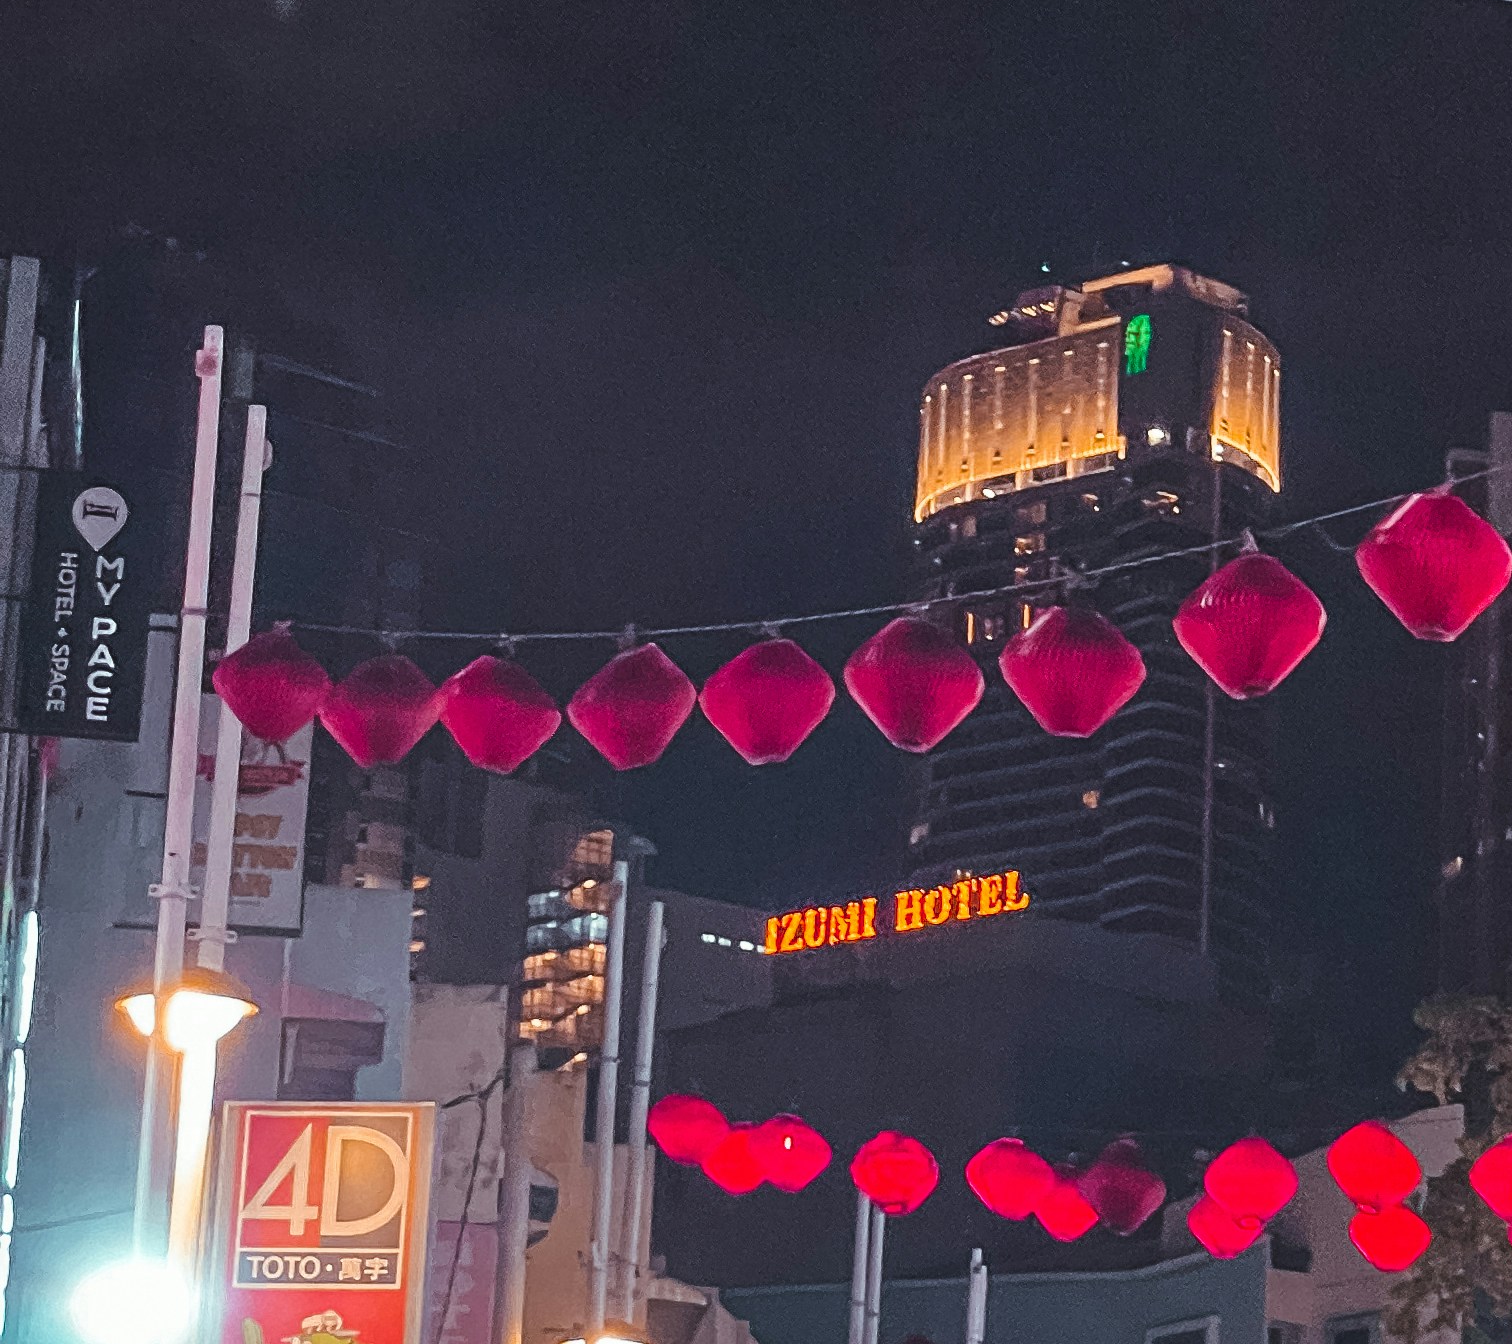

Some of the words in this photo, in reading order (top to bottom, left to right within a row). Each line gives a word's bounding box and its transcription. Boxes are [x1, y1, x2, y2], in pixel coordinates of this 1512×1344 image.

[54, 552, 79, 623] HOTEL
[95, 555, 125, 606] MY
[46, 643, 71, 713] SPACE
[85, 616, 118, 723] PACE
[764, 897, 879, 955] IZUMI
[895, 870, 1031, 932] HOTEL
[240, 1122, 410, 1236] 4D
[246, 1255, 321, 1280] TOTO
